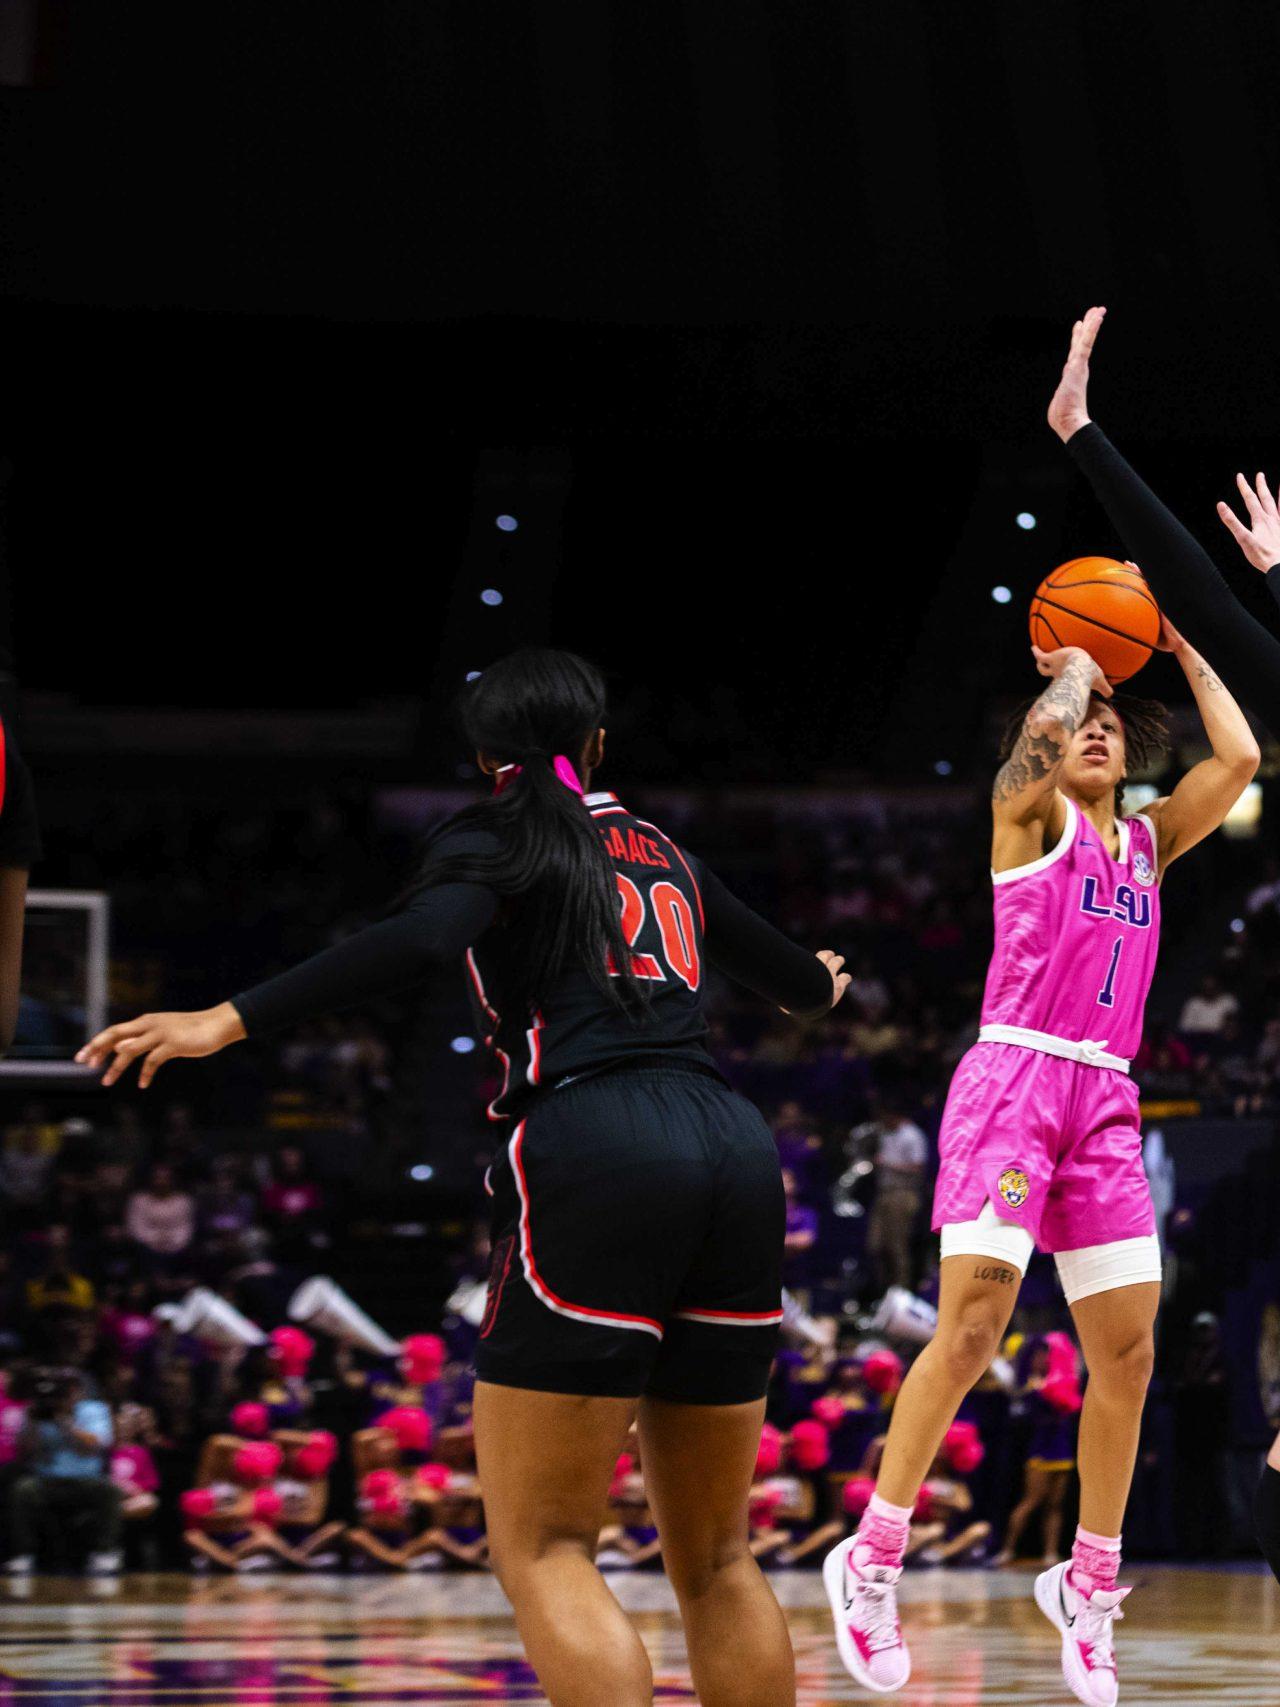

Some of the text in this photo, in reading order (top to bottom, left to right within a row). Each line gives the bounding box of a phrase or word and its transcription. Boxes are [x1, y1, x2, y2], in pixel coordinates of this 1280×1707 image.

[600, 827, 671, 870] AACS
[606, 872, 700, 992] 20
[1080, 875, 1152, 928] LSU
[1096, 935, 1124, 1008] 1
